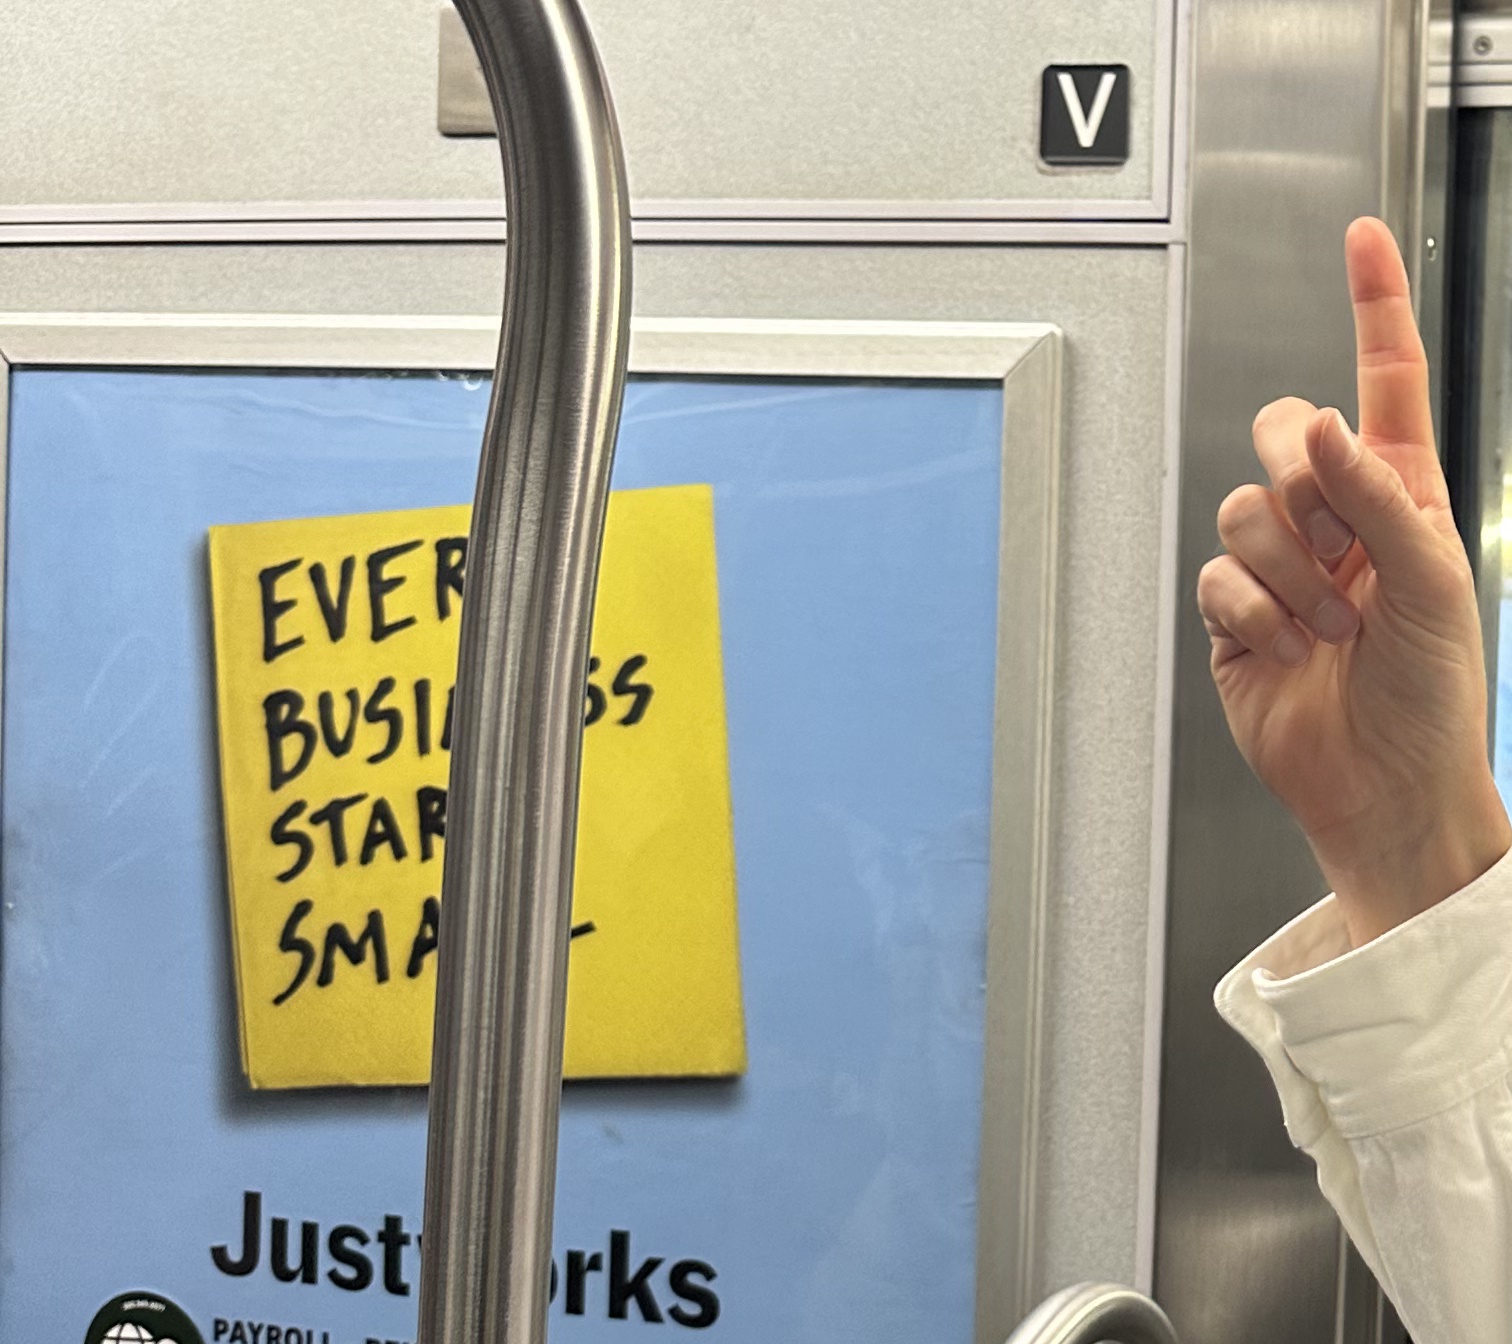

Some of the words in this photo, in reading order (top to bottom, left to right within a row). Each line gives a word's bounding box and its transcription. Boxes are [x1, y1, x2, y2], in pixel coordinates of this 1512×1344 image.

[1057, 72, 1117, 148] V
[258, 537, 470, 662] EVER
[270, 785, 446, 883] STAR
[272, 897, 596, 1006] SMA
[211, 1191, 721, 1329] Justrks
